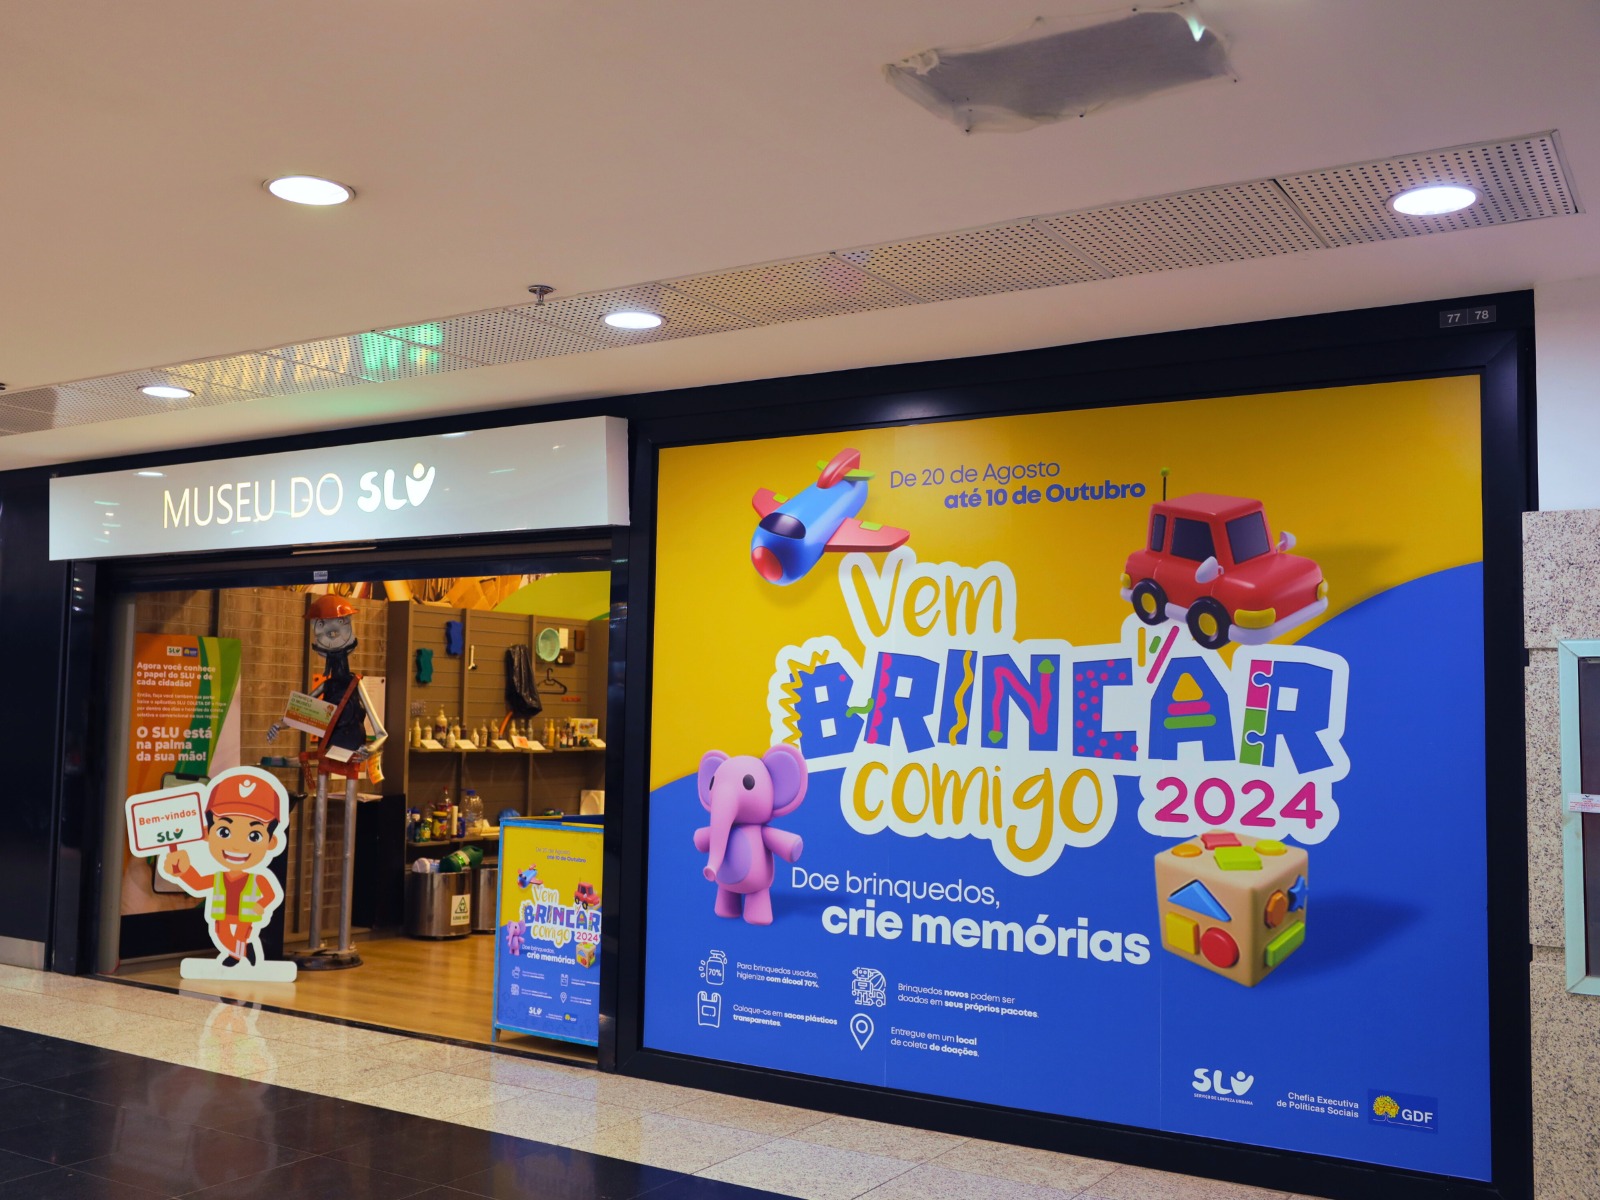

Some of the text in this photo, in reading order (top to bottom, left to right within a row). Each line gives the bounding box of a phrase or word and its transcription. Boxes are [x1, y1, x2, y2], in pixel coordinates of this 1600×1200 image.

[1447, 313, 1461, 324] 77
[1475, 310, 1489, 320] 78
[890, 461, 1060, 488] De 20 de Agosto
[163, 463, 436, 528] MUSEU DO SLU
[944, 480, 1146, 509] até 10 de Outubro
[850, 555, 1003, 637] Vem
[137, 662, 161, 670] Agora
[144, 671, 166, 679] papel
[782, 646, 1334, 774] BRINCAR
[136, 726, 212, 739] O SLU está
[136, 739, 192, 751] na palma
[136, 751, 206, 761] da sua mão!
[1155, 776, 1324, 829] 2024
[139, 810, 197, 826] Bem-vindos
[853, 761, 1101, 862] comigo
[156, 828, 183, 843] SLU
[533, 885, 557, 902] Vem
[791, 867, 1000, 909] Doe brinquedos,
[523, 903, 600, 932] BRINCAR
[532, 925, 570, 945] comigo
[576, 931, 598, 942] 2024
[821, 899, 1151, 965] crie memórias
[527, 951, 575, 965] crie memórias
[708, 968, 722, 977] 70%
[736, 962, 819, 979] Para brinquedos usados,
[736, 971, 765, 982] higienize
[782, 976, 803, 986] álcool
[898, 983, 1015, 1004] Brinquedos novos podem ser
[733, 1004, 838, 1025] Coloque-os em sacos plásticos
[898, 994, 1039, 1018] doados em seus próprios pacotes.
[733, 1014, 782, 1027] transparentes.
[891, 1027, 926, 1039] Entregue
[956, 1035, 977, 1045] local
[891, 1038, 979, 1057] de coleta de doações.
[1192, 1068, 1254, 1096] SLU
[1276, 1099, 1359, 1118] de Políticas Sociais
[1288, 1092, 1359, 1109] Chefia Executiva
[1402, 1109, 1433, 1124] GDF
